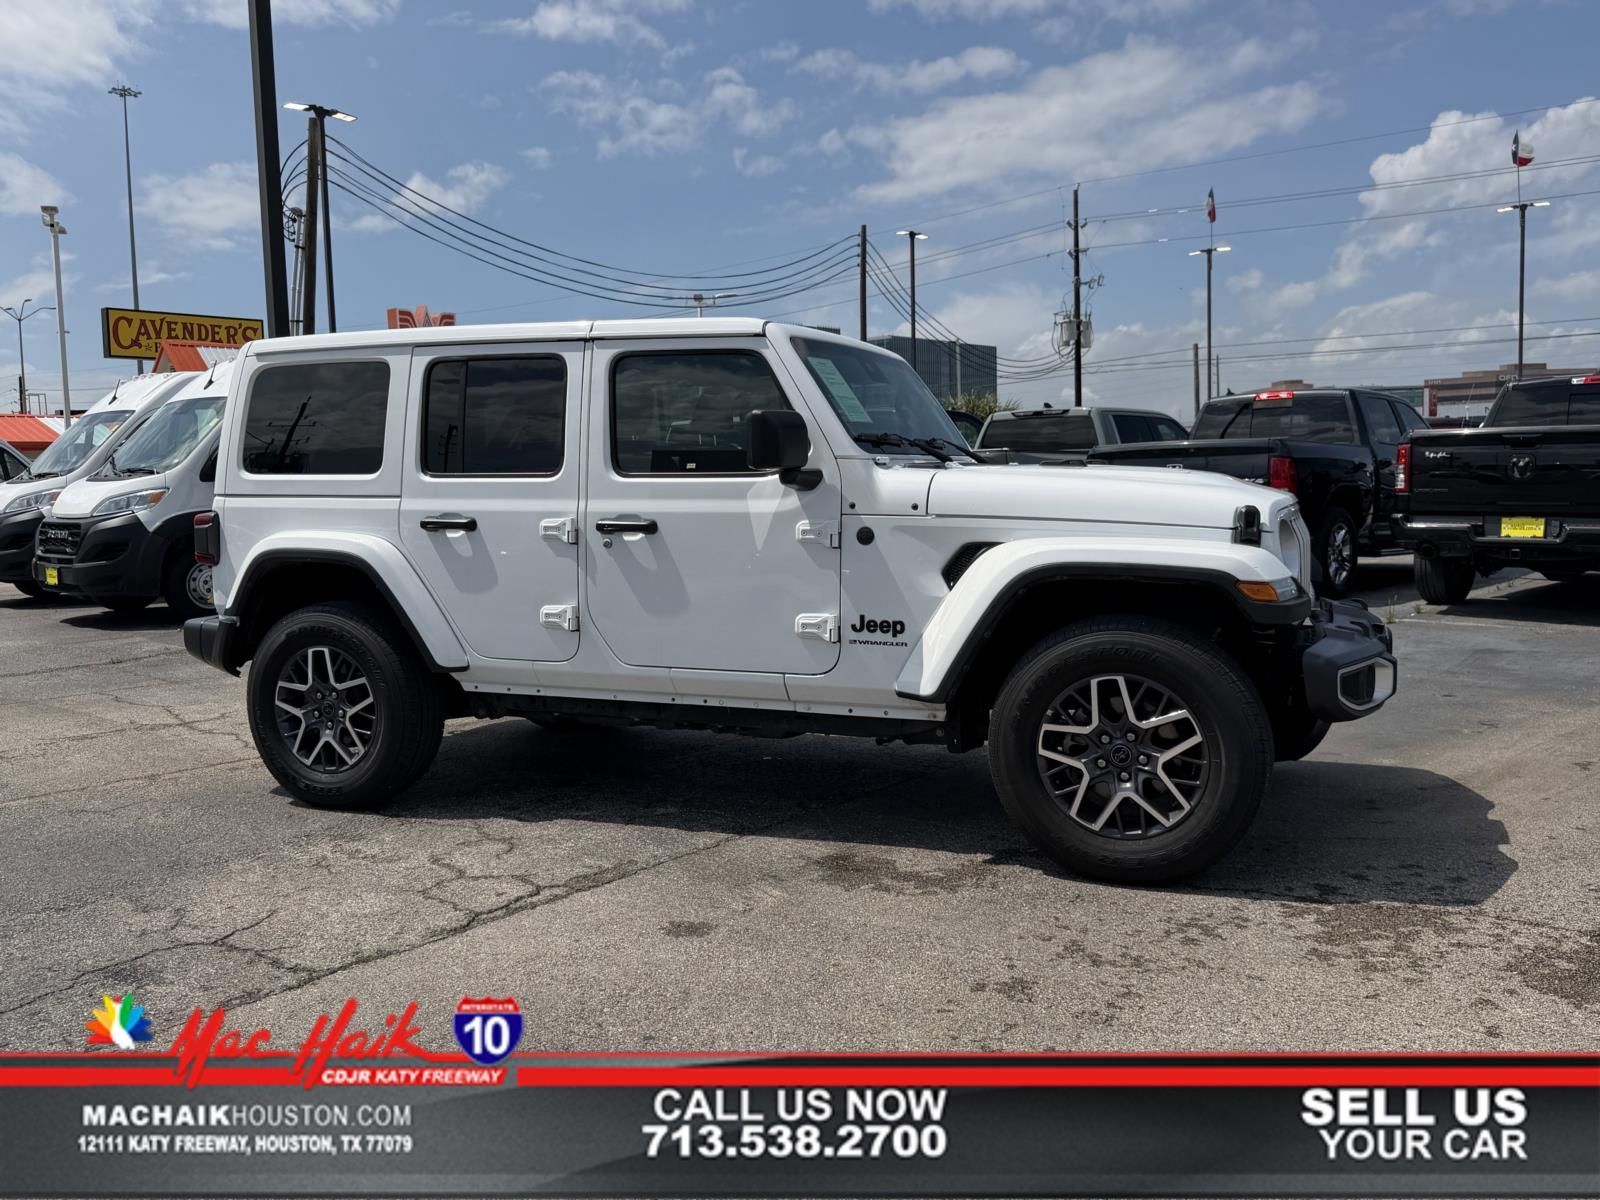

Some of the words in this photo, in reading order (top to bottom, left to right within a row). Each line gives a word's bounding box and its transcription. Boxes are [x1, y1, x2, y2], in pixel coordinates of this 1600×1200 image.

[112, 316, 259, 349] CAVENDER'S
[851, 614, 906, 638] Jeep
[858, 639, 908, 647] WRANGLER
